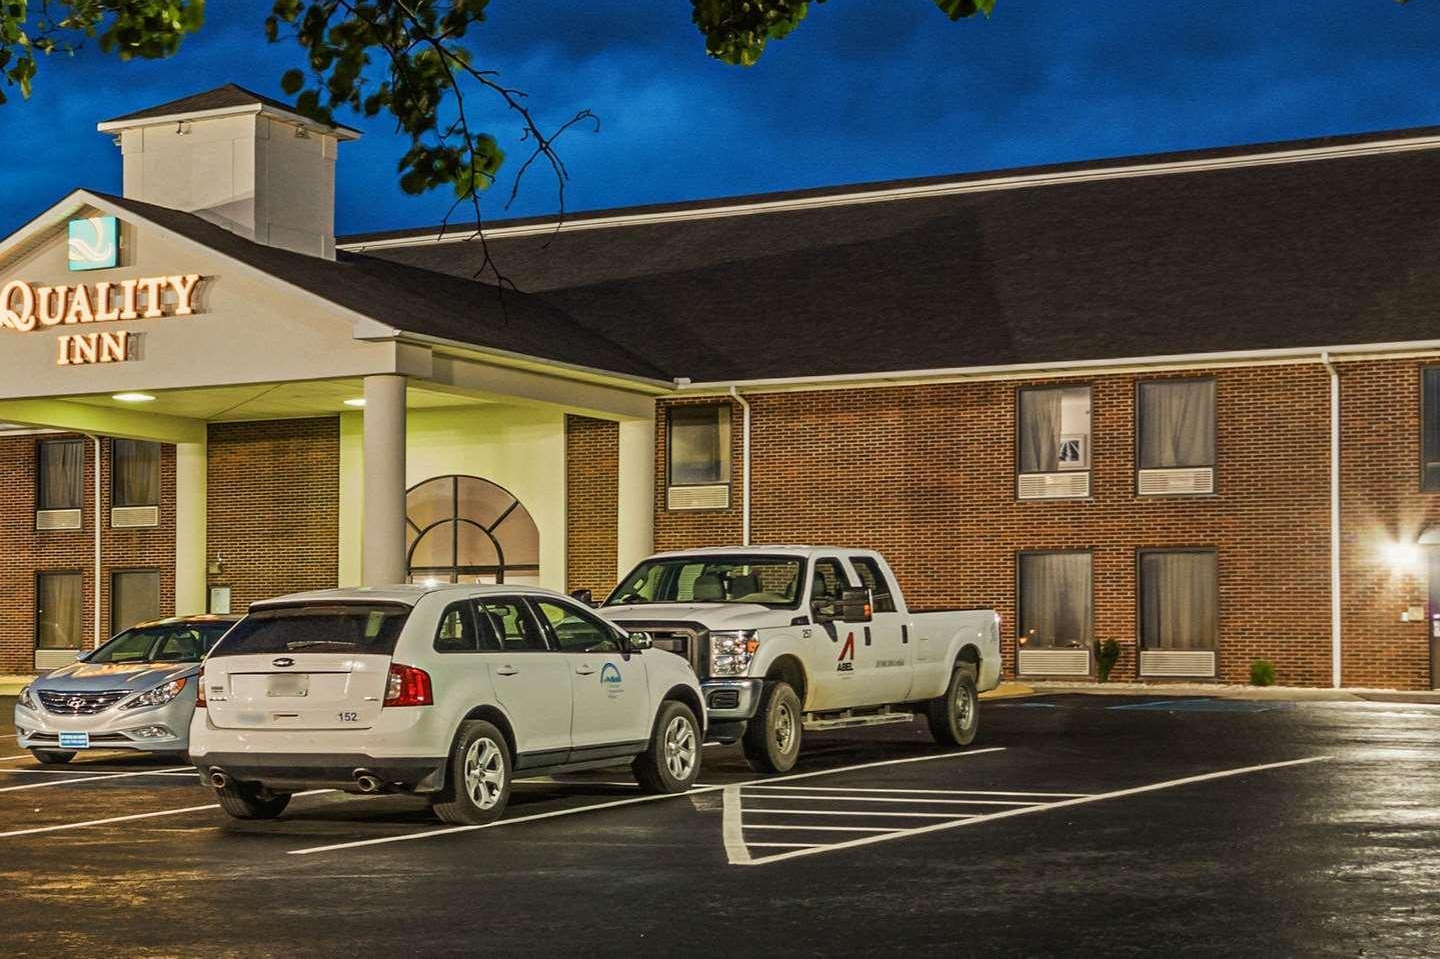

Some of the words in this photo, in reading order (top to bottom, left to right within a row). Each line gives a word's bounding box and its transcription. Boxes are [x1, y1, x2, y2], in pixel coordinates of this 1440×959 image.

[56, 330, 130, 365] INN
[837, 662, 854, 672] ABEL
[338, 712, 358, 722] 152
